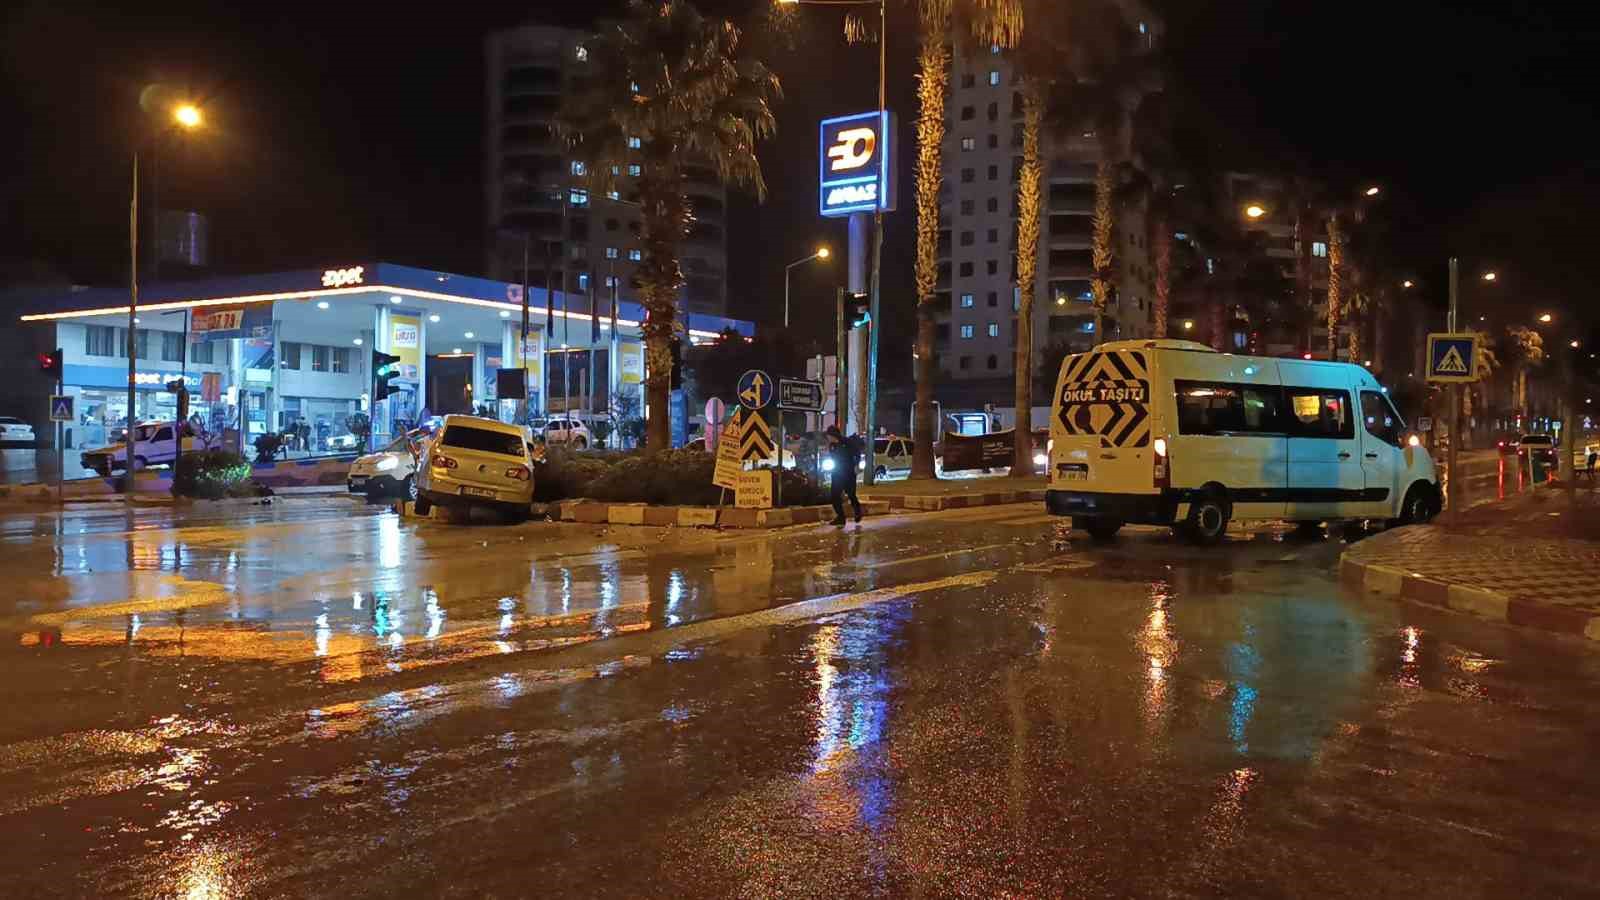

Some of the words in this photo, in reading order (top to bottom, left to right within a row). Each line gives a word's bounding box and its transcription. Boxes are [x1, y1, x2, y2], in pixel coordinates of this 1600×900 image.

[322, 266, 363, 287] opet
[1063, 389, 1096, 403] OKUL
[1100, 387, 1145, 403] TAŞITI
